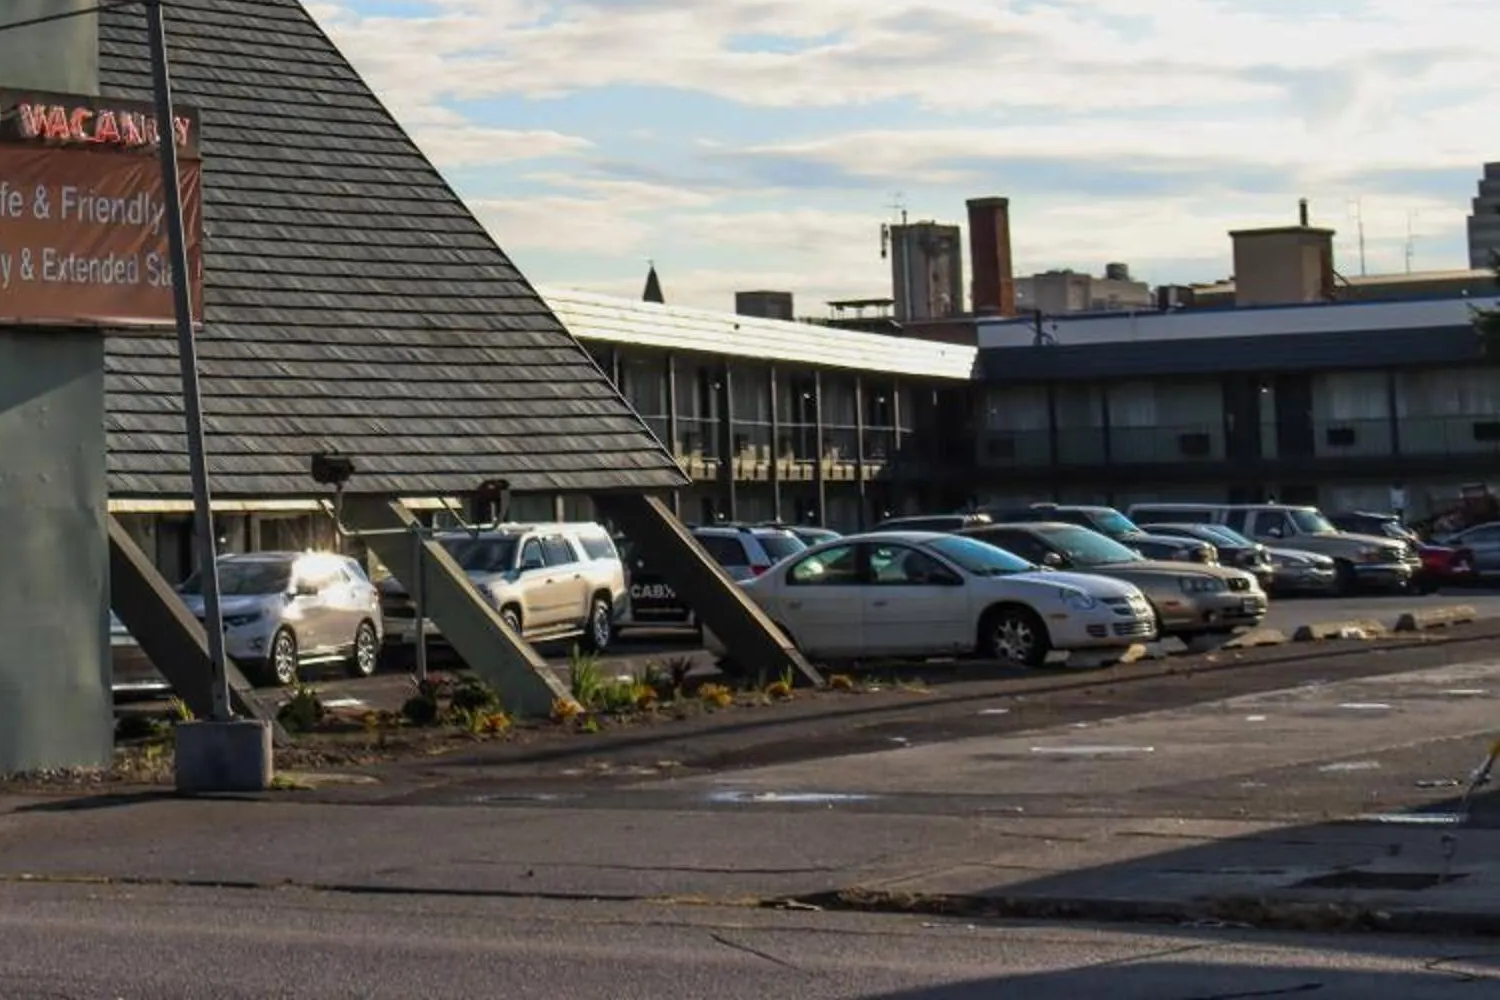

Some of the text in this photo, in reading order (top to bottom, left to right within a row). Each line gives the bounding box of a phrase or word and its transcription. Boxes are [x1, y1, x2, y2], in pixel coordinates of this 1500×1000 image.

[33, 185, 50, 220] &
[61, 186, 165, 236] Friendly
[20, 248, 35, 282] &
[43, 250, 139, 286] Extended
